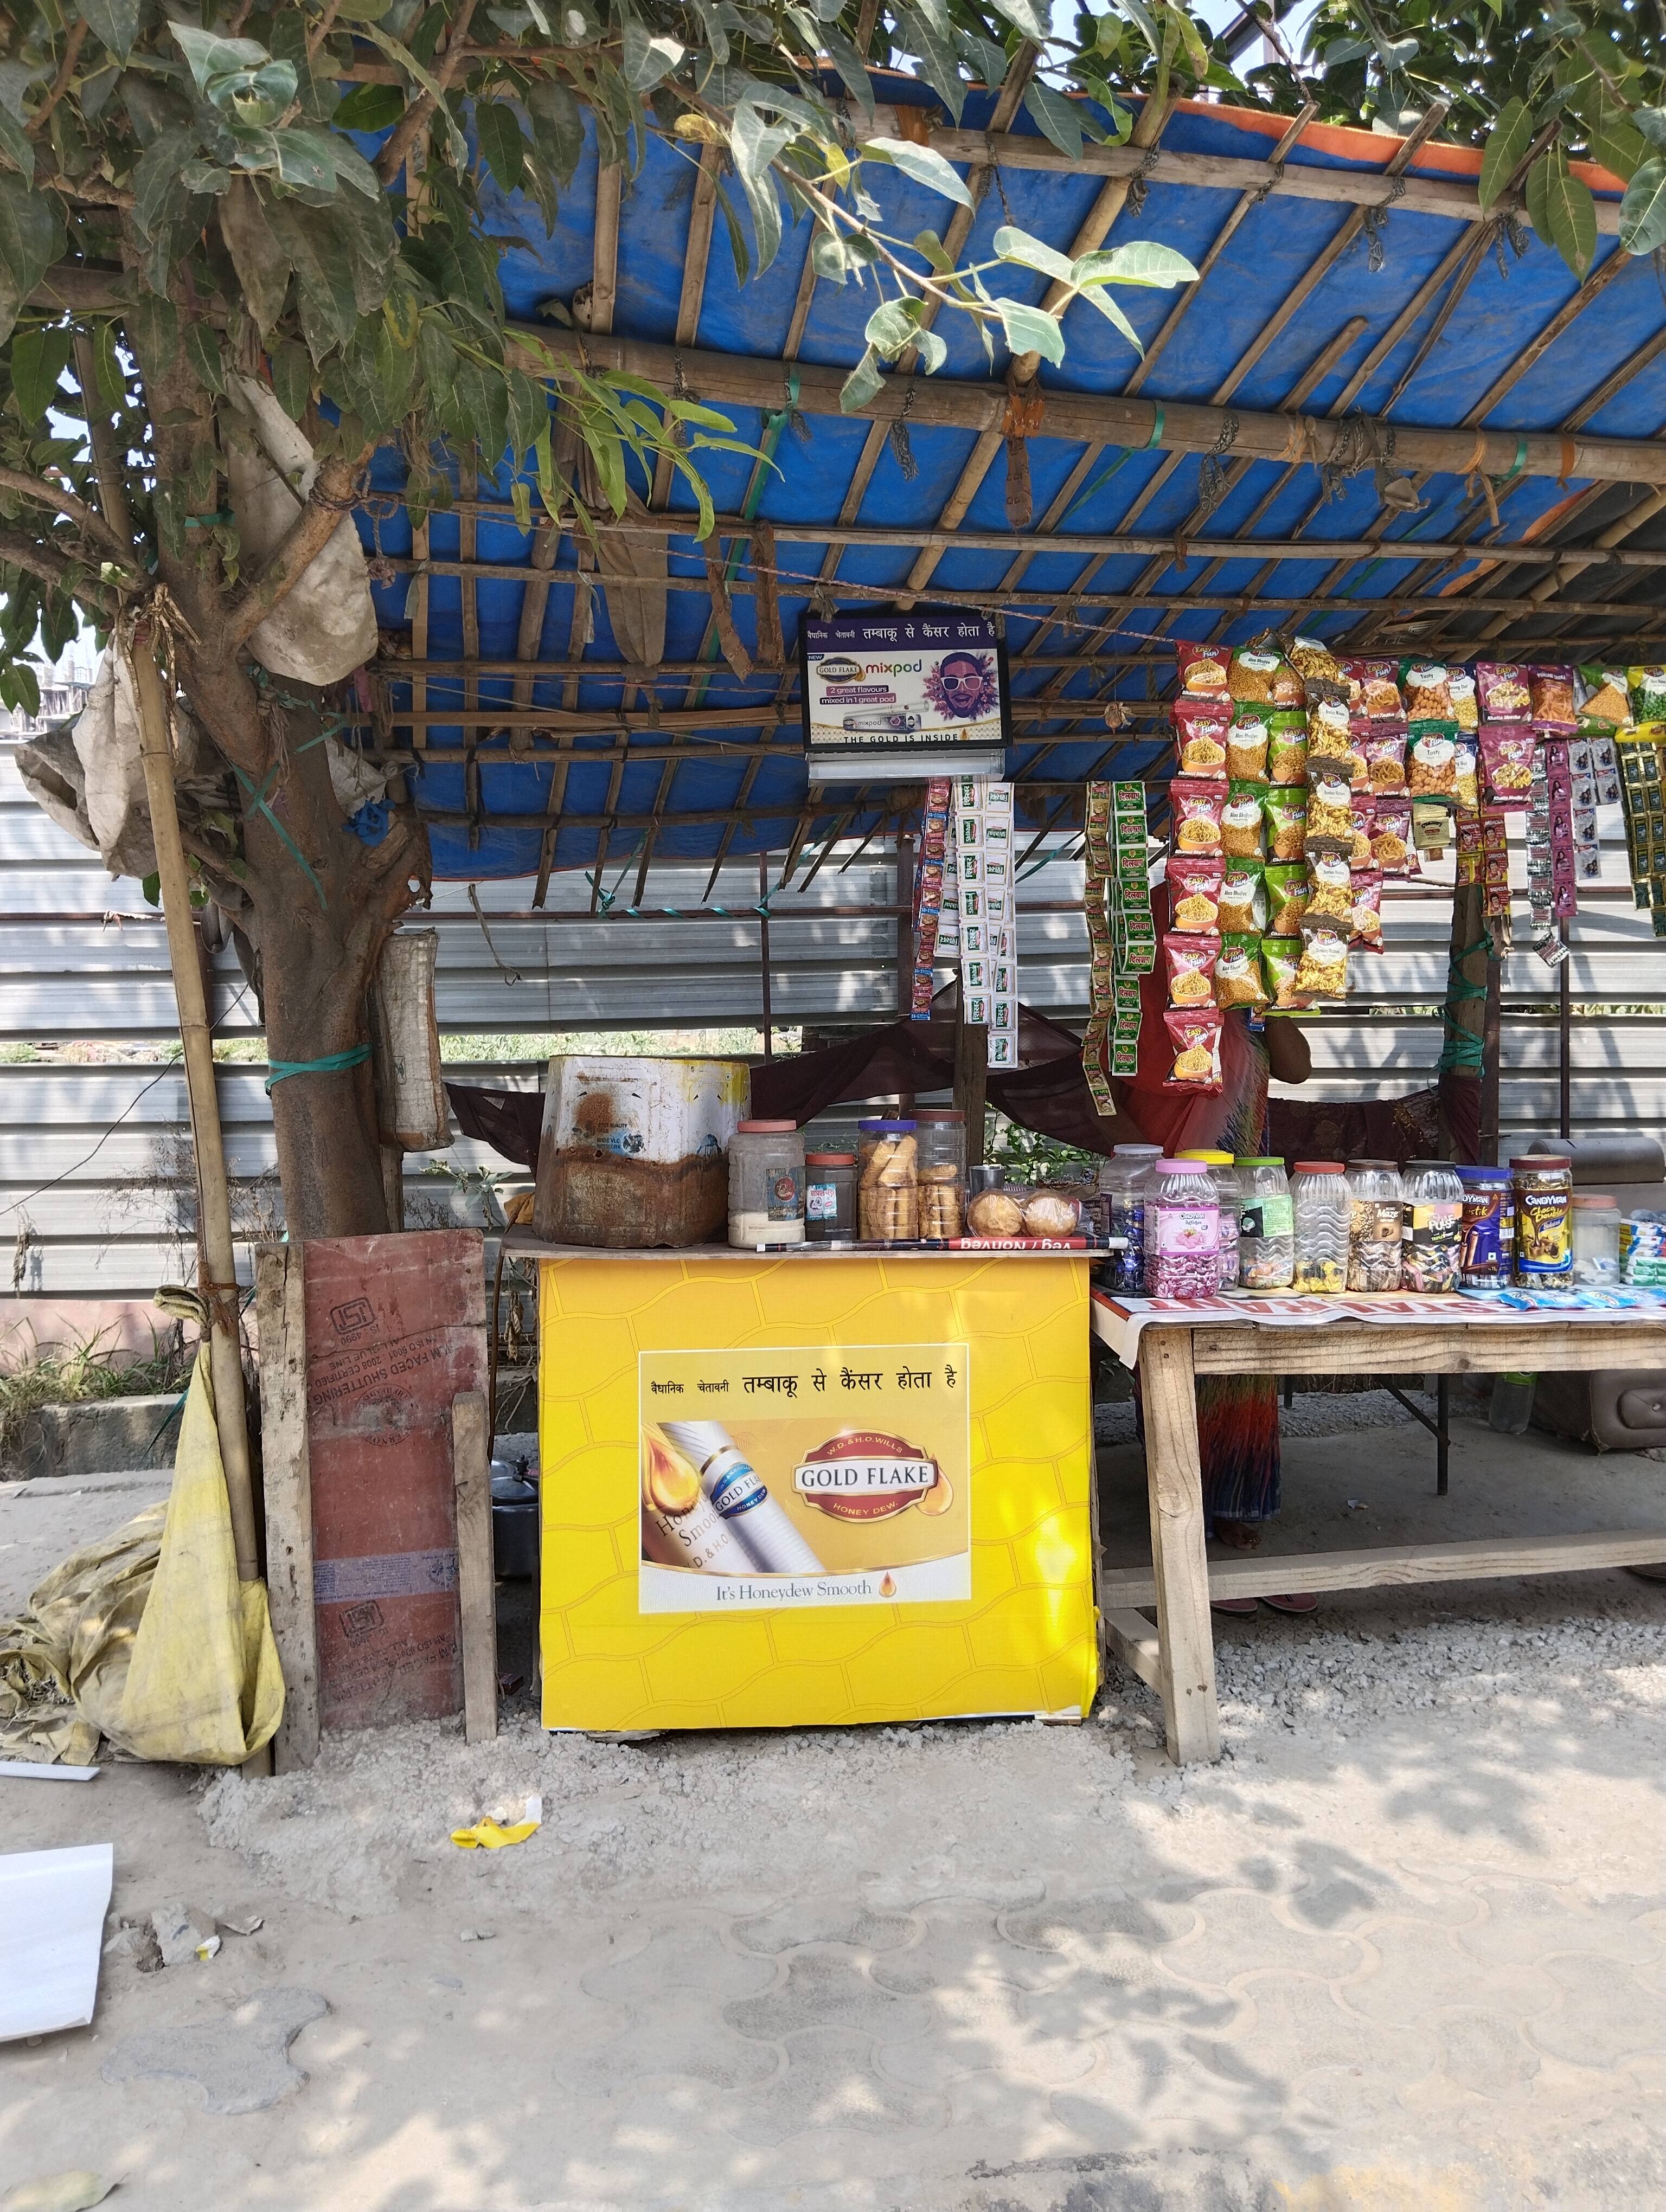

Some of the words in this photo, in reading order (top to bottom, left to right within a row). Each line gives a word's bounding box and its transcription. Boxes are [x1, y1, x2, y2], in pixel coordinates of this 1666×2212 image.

[862, 628, 898, 642] तम्बाकू
[905, 623, 915, 638] से
[922, 623, 949, 638] कैंसर
[957, 622, 980, 637] होता
[986, 621, 996, 636] है
[866, 659, 922, 677] mixpod
[858, 697, 878, 705] great
[879, 696, 894, 704] pod
[921, 734, 958, 742] INSIDE
[1376, 1209, 1398, 1218] Maze
[1530, 1206, 1555, 1216] Choco
[1535, 1209, 1562, 1223] Double
[1428, 1214, 1455, 1231] PULSE
[341, 1332, 362, 1346] 4990
[328, 1356, 352, 1371] LINE
[390, 1355, 429, 1375] FACED
[313, 1368, 388, 1405] SHUTTERING
[651, 1381, 684, 1394] वैधानिक
[697, 1379, 729, 1393] चेतावनी
[742, 1375, 798, 1398] तम्बाकू
[811, 1368, 827, 1392] से
[840, 1367, 883, 1390] कैंसर
[896, 1366, 932, 1390] होता
[944, 1364, 957, 1388] है
[802, 1468, 858, 1487] GOLD
[867, 1465, 928, 1484] FLAKE
[716, 1486, 743, 1512] GOLD
[737, 1497, 758, 1511] HONEY
[833, 1503, 869, 1515] HONEY
[706, 1548, 715, 1559] &
[717, 1585, 735, 1600] It's
[739, 1583, 813, 1601] Honeydew
[817, 1580, 872, 1597] Smooth
